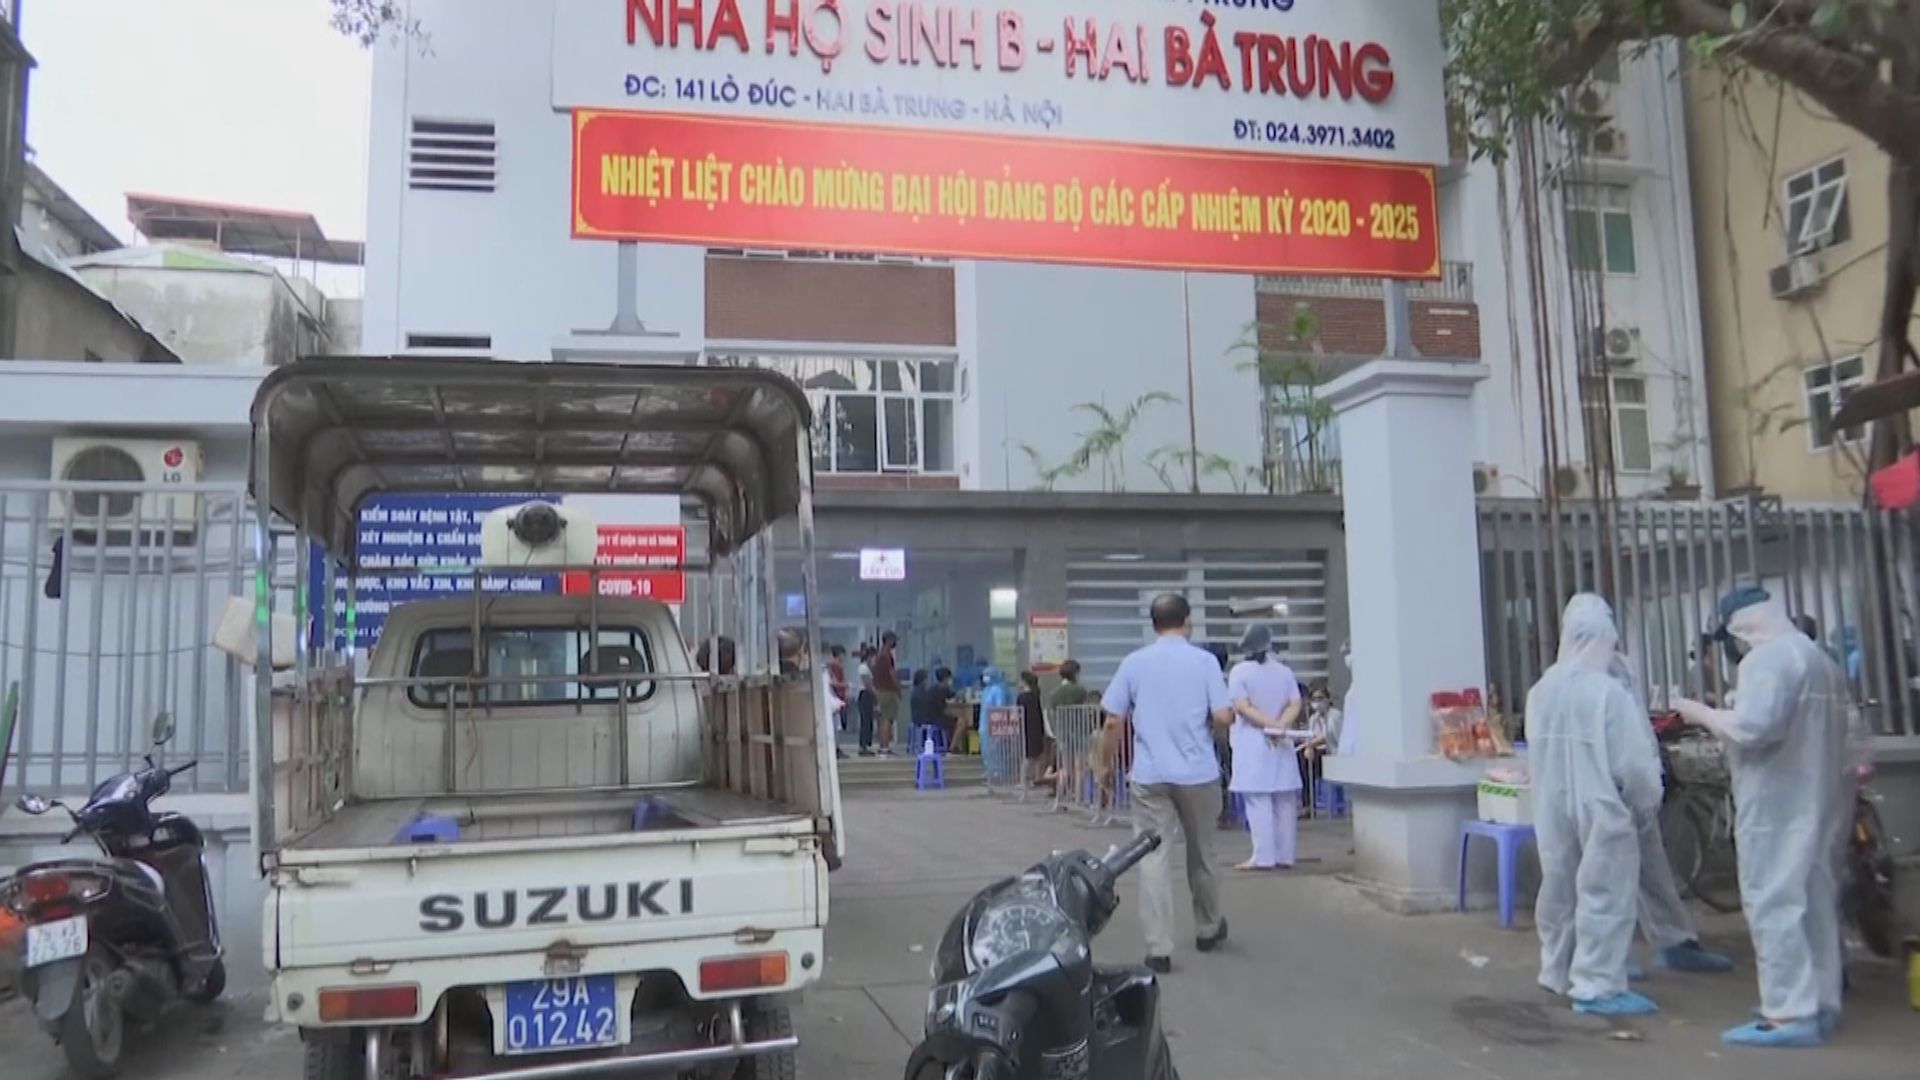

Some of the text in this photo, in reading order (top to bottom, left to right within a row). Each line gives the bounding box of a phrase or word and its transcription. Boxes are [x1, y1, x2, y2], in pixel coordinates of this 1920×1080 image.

[865, 3, 983, 71] SINH
[997, 9, 1027, 73] B
[1036, 36, 1055, 54] -
[1064, 14, 1150, 84] HAI
[1163, 9, 1231, 90] BÀ
[1234, 30, 1395, 106] TRƯNG
[625, 73, 667, 99] ĐC:
[676, 77, 704, 102] 141
[711, 73, 740, 103] LÒ
[748, 78, 797, 108] ĐÚC
[817, 87, 854, 113] HAI
[860, 86, 889, 116] BÀ
[985, 93, 1016, 123] HÀ
[1023, 99, 1063, 129] NỘI
[1234, 118, 1396, 150] ĐT: 024.3971.3402
[601, 146, 675, 208] NHIỆT
[682, 152, 733, 212] LIỆT
[740, 155, 805, 208] CHÀO
[813, 159, 885, 212] MỪNG
[892, 172, 932, 224] ĐẠI
[939, 169, 977, 226] HỘI
[984, 163, 1047, 223] ĐẢNG
[1053, 176, 1084, 234] BỘ
[1090, 177, 1136, 226] CÁC
[1141, 177, 1186, 230] CẤP
[1191, 185, 1262, 241] NHIỆM
[1267, 188, 1294, 235] KỲ
[1300, 198, 1351, 238] 2020
[1370, 202, 1420, 242] 2025
[163, 472, 182, 483] LG
[419, 876, 695, 935] SUZUKI
[532, 977, 591, 1011] 29A
[508, 1006, 616, 1049] 012.42
